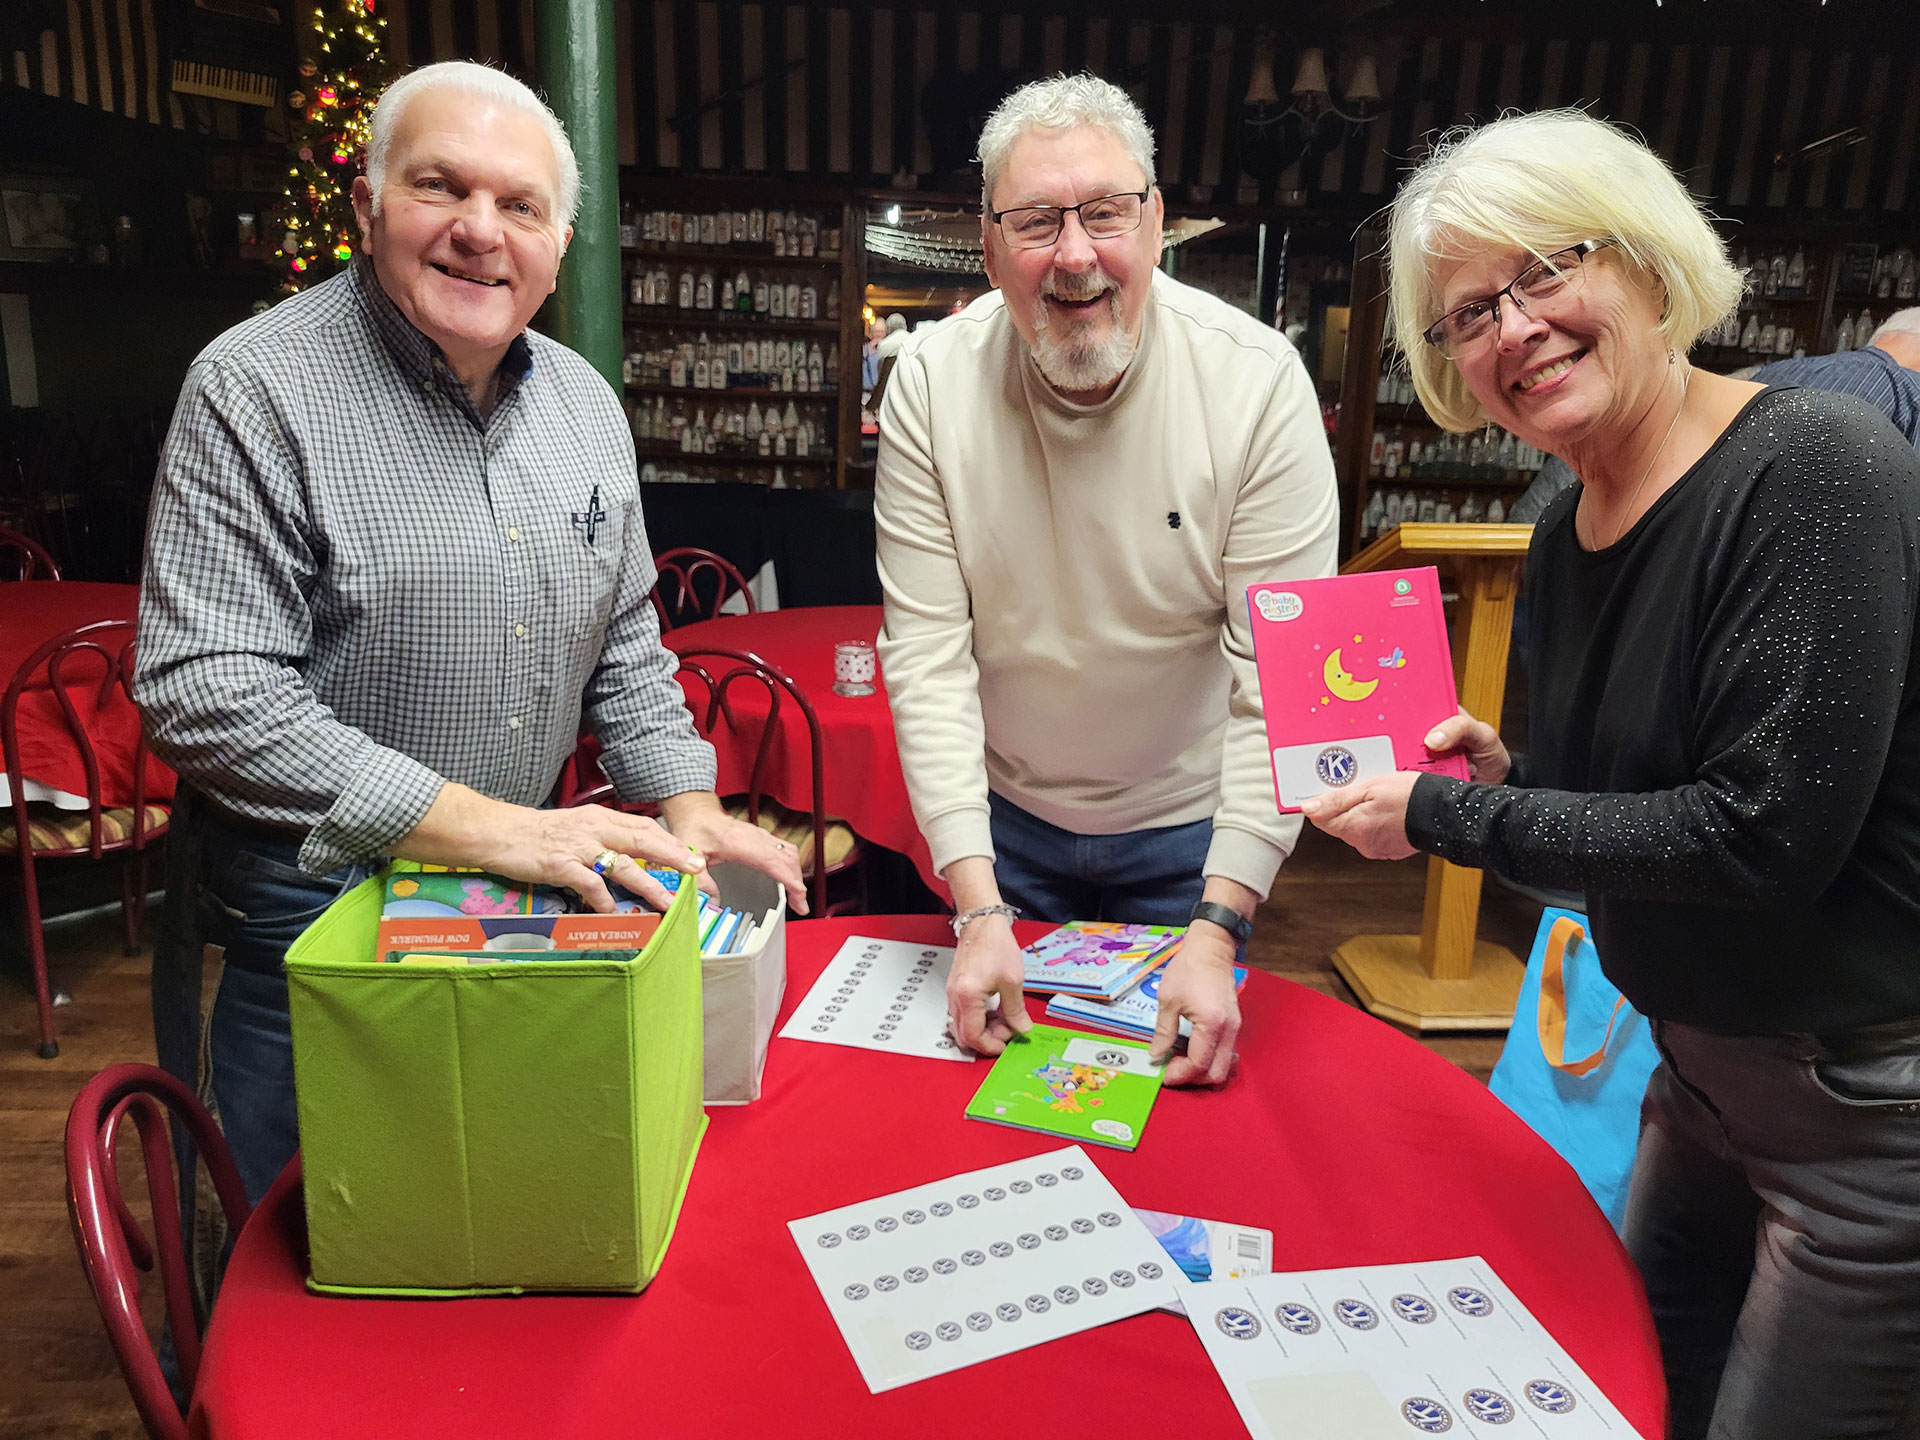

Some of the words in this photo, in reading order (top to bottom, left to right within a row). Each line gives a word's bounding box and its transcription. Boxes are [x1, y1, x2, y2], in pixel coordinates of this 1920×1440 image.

[1271, 596, 1295, 606] baby
[446, 934, 470, 944] DOW
[568, 931, 599, 941] BEATY
[600, 930, 642, 940] ANDREA
